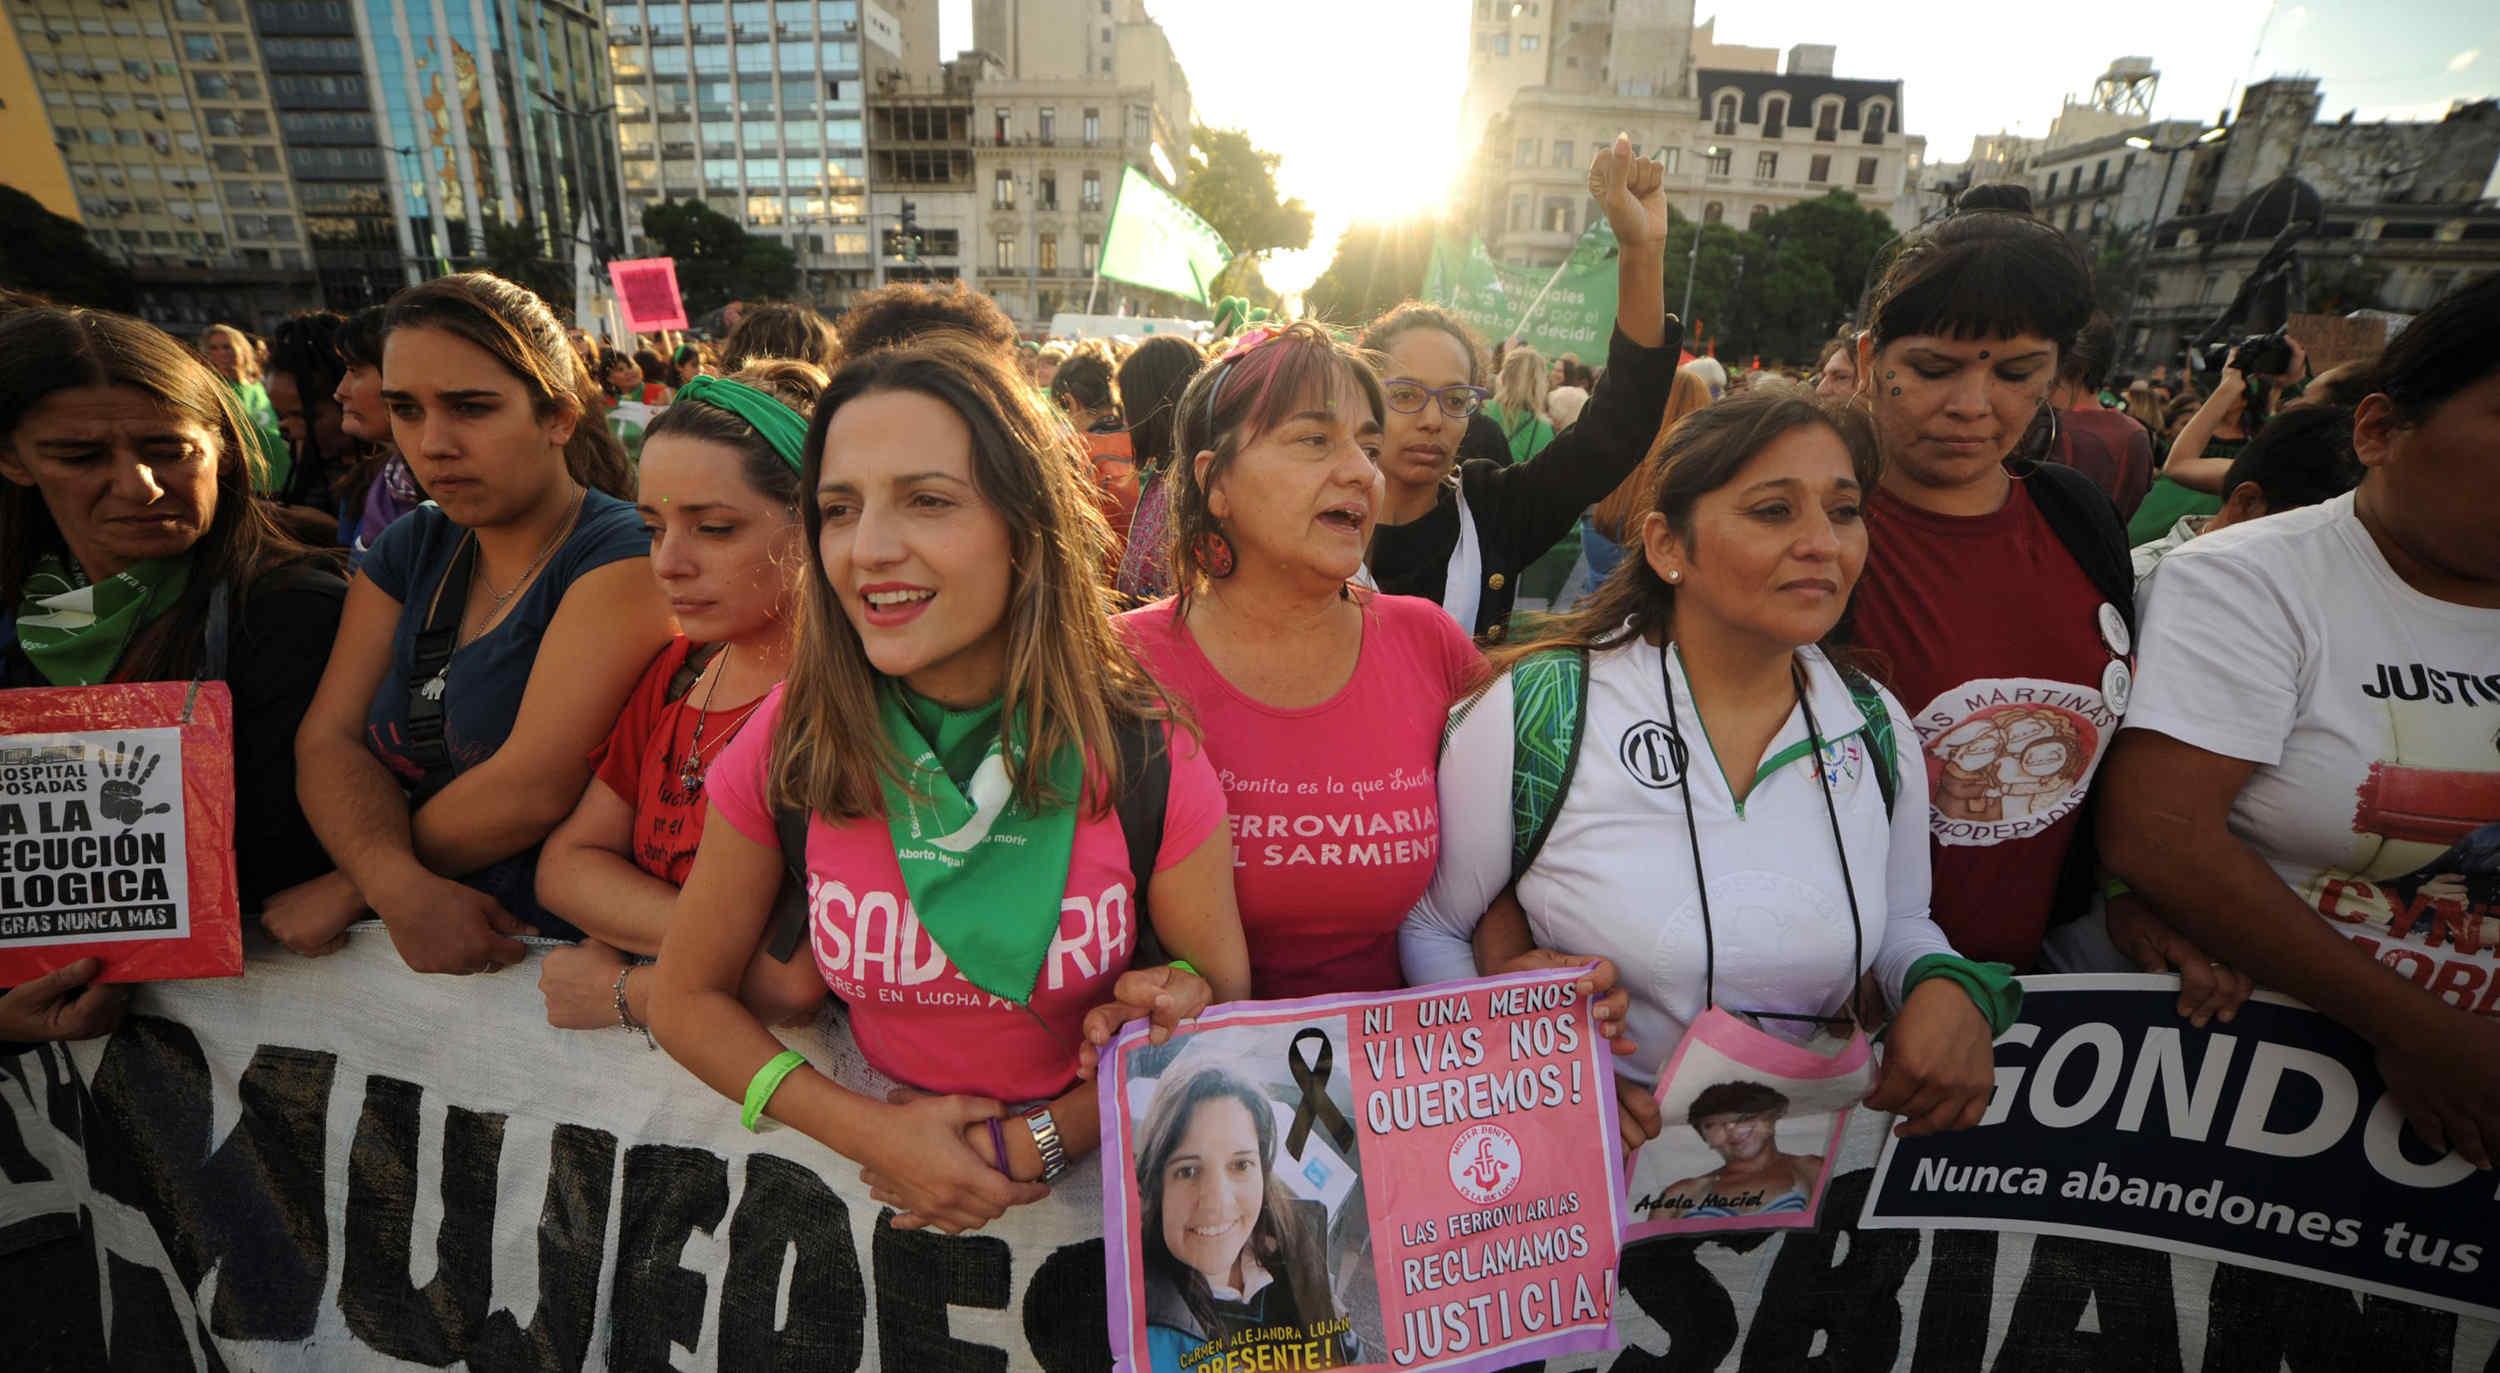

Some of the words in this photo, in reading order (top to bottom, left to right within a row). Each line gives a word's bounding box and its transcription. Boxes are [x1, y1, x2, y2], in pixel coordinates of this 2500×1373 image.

[1536, 321, 1598, 342] decidir
[1913, 711, 1954, 746] AS
[1966, 687, 2115, 729] MARTINAS
[0, 763, 88, 781] OSPITAL
[1219, 767, 1290, 795] Bonita
[1297, 781, 1320, 795] es
[1326, 775, 1345, 795] la
[1351, 777, 1386, 801] que
[1390, 766, 1435, 792] Luch
[38, 799, 93, 834] LA
[1229, 802, 1439, 839] ERROVIARIA
[899, 848, 936, 861] Aborto
[993, 832, 1029, 848] morir
[1263, 834, 1439, 867] SARMIENT
[57, 909, 124, 932] NUNCA
[128, 908, 168, 928] MAS
[879, 988, 905, 1005] EN
[916, 990, 982, 1008] LUCHA
[1363, 1004, 1394, 1036] NI
[1418, 995, 1473, 1028] UNA
[1488, 982, 1578, 1020] MENOS
[1365, 1027, 1486, 1081] VIVAS
[1510, 1012, 1580, 1062] NOS
[1366, 1059, 1583, 1135] QUEREMOS!
[1979, 1022, 2500, 1201] GONDO
[1402, 1219, 1439, 1248] LAS
[1447, 1191, 1582, 1239] FERROVIARIAS
[1910, 1156, 2048, 1196] Nunca
[2060, 1161, 2364, 1249] abandones
[2383, 1220, 2485, 1274] tus
[1403, 1224, 1591, 1297] RECLAMAMOS
[1392, 1268, 1615, 1367] JUSTICIA!
[1180, 1338, 1223, 1369] CARMEN
[1231, 1325, 1303, 1348] ALEJANDRA
